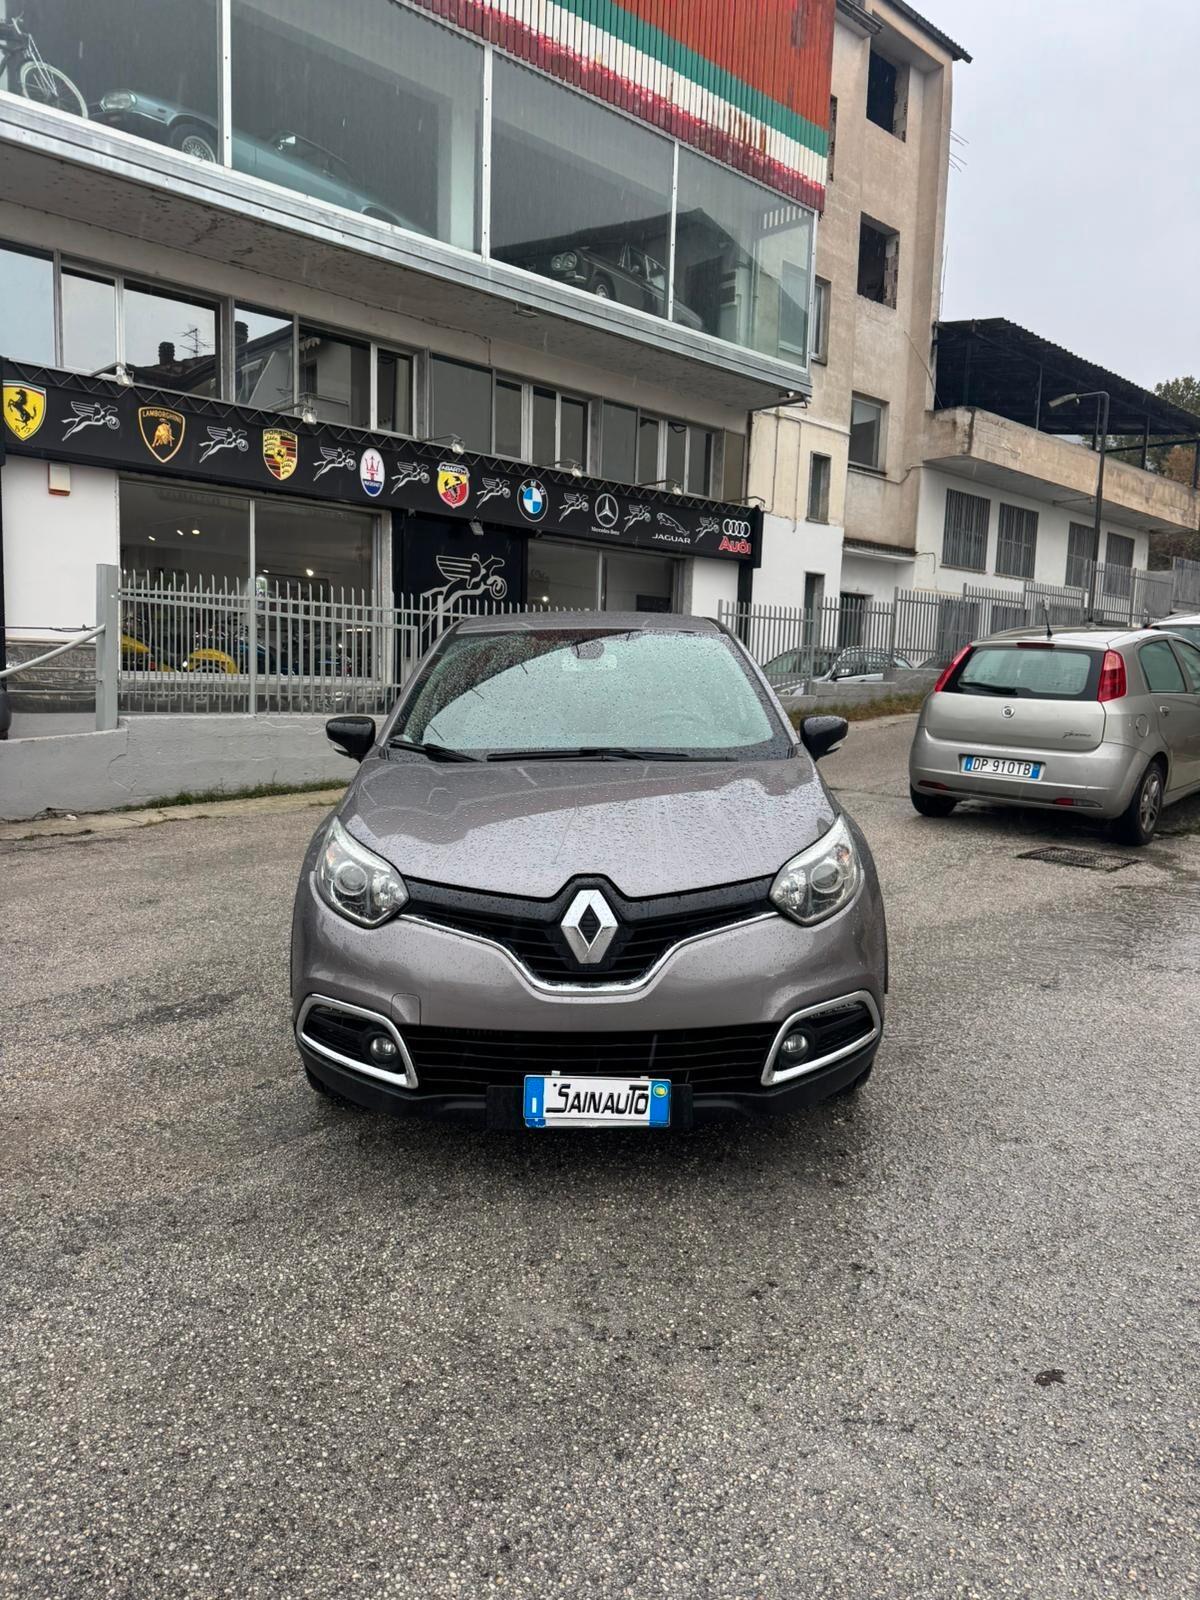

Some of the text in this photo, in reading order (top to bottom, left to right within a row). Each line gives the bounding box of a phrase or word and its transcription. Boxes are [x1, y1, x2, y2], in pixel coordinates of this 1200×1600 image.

[520, 480, 547, 496] BMW
[652, 533, 691, 545] JAGUAR
[719, 536, 752, 554] Audi
[973, 758, 1032, 776] DP 910TB
[545, 1083, 650, 1115] SAINAUTO
